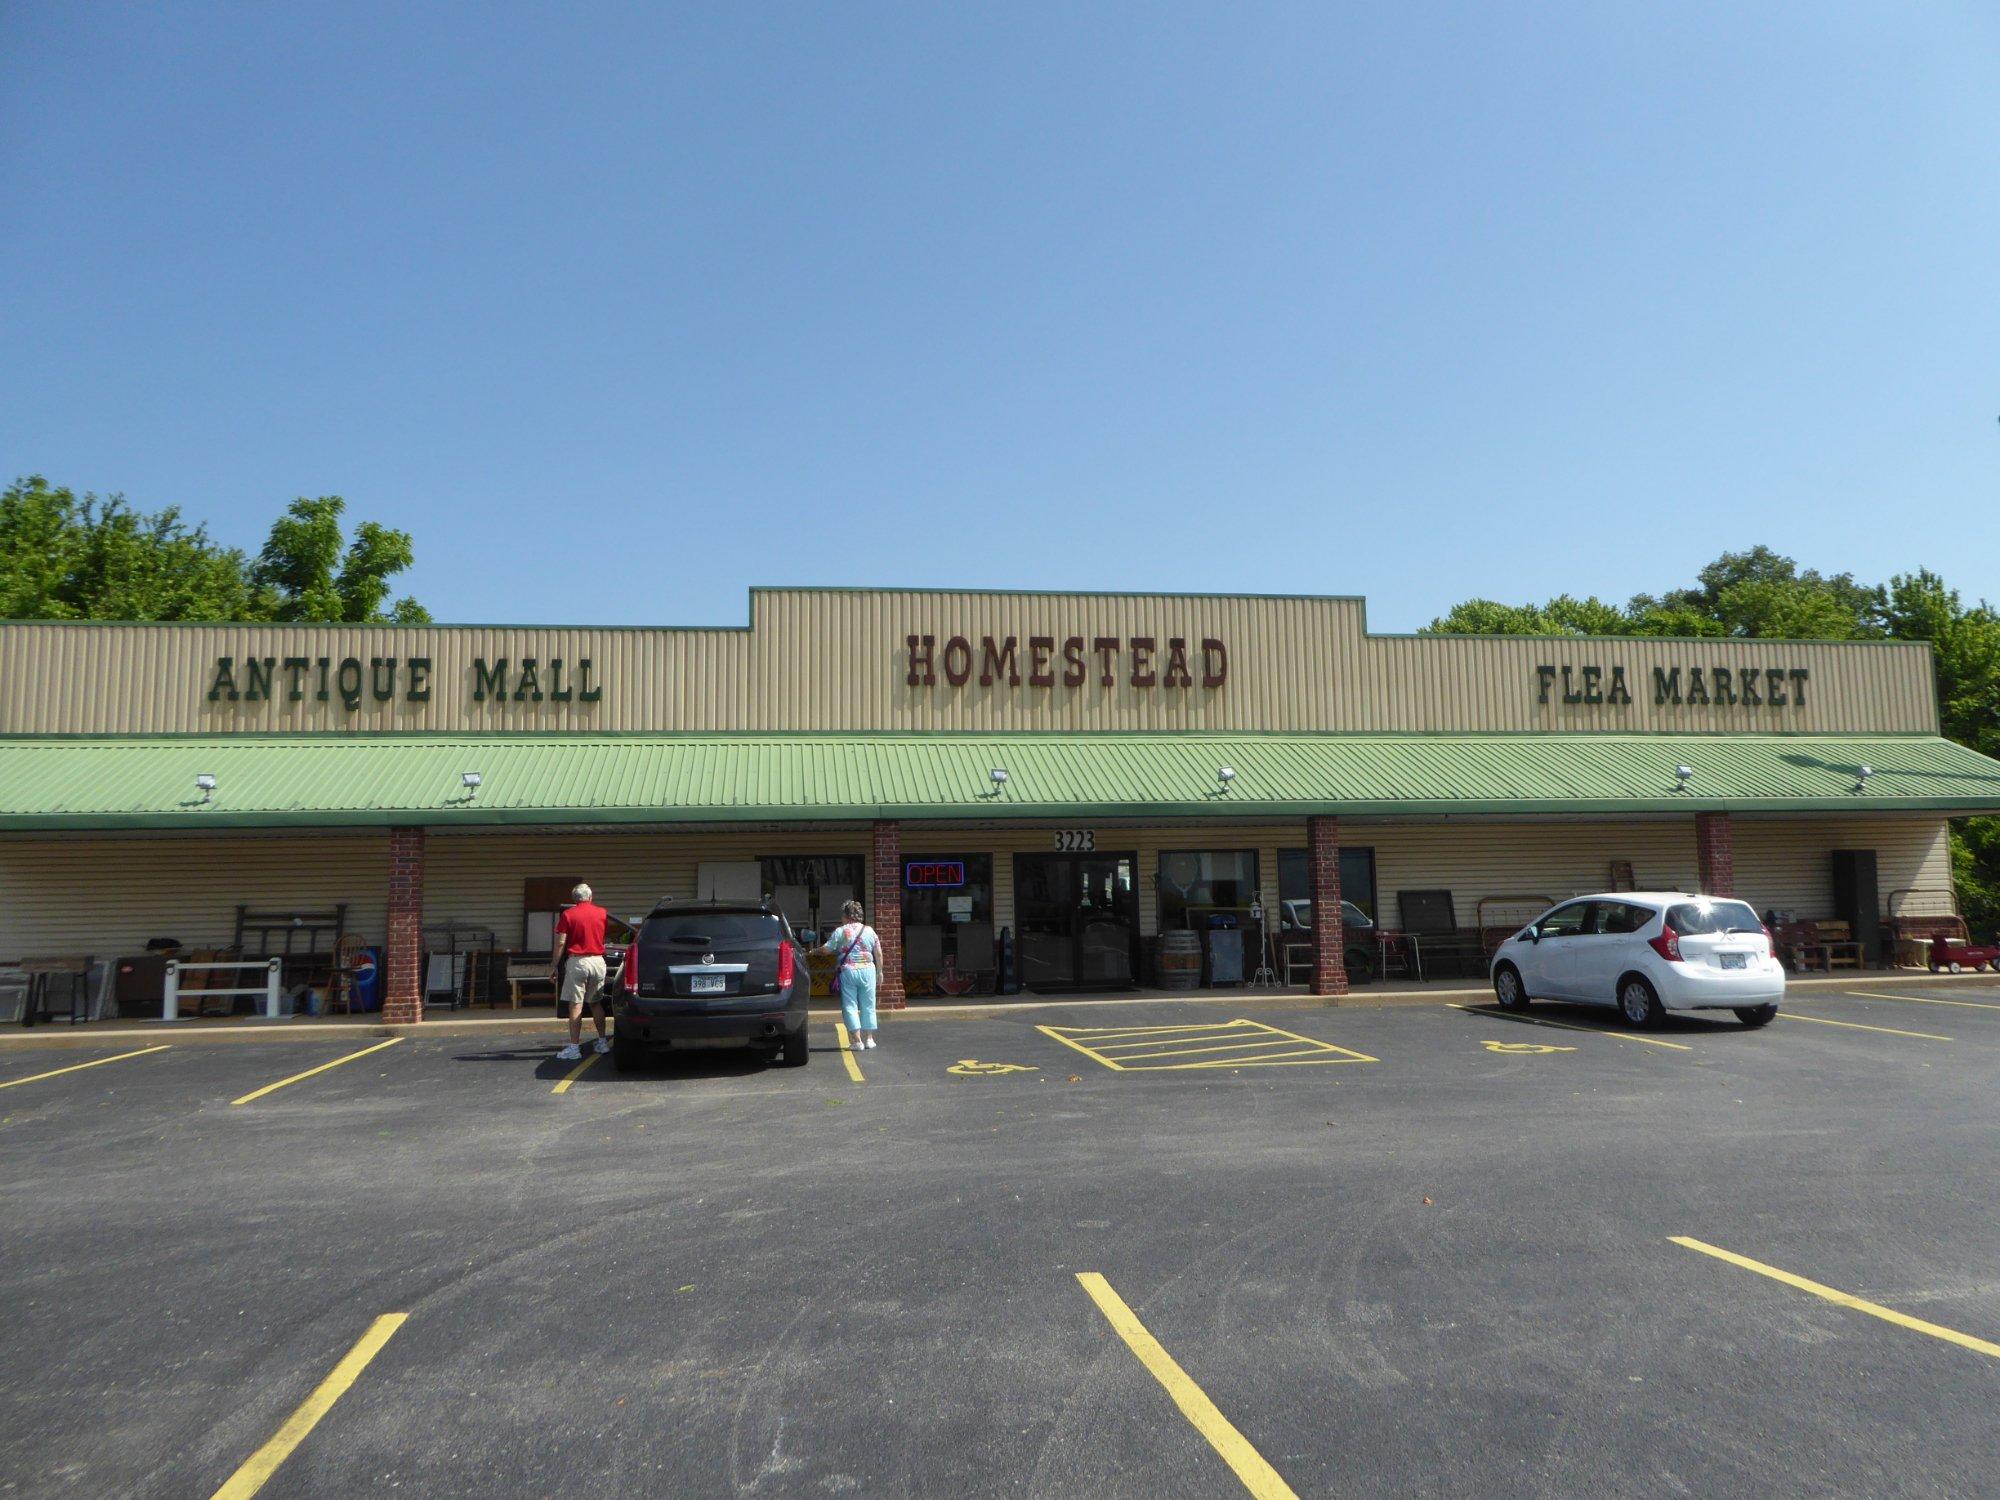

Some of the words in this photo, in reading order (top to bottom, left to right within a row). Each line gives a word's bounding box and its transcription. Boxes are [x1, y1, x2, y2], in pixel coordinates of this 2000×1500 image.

[907, 635, 1228, 687] HOMESTEAD
[208, 657, 432, 709] ANTIQUE
[473, 657, 601, 702] MALL
[1537, 665, 1632, 704] FLEA
[1653, 667, 1809, 706] MARKET
[1055, 830, 1095, 851] 3223
[909, 865, 961, 884] OPEN
